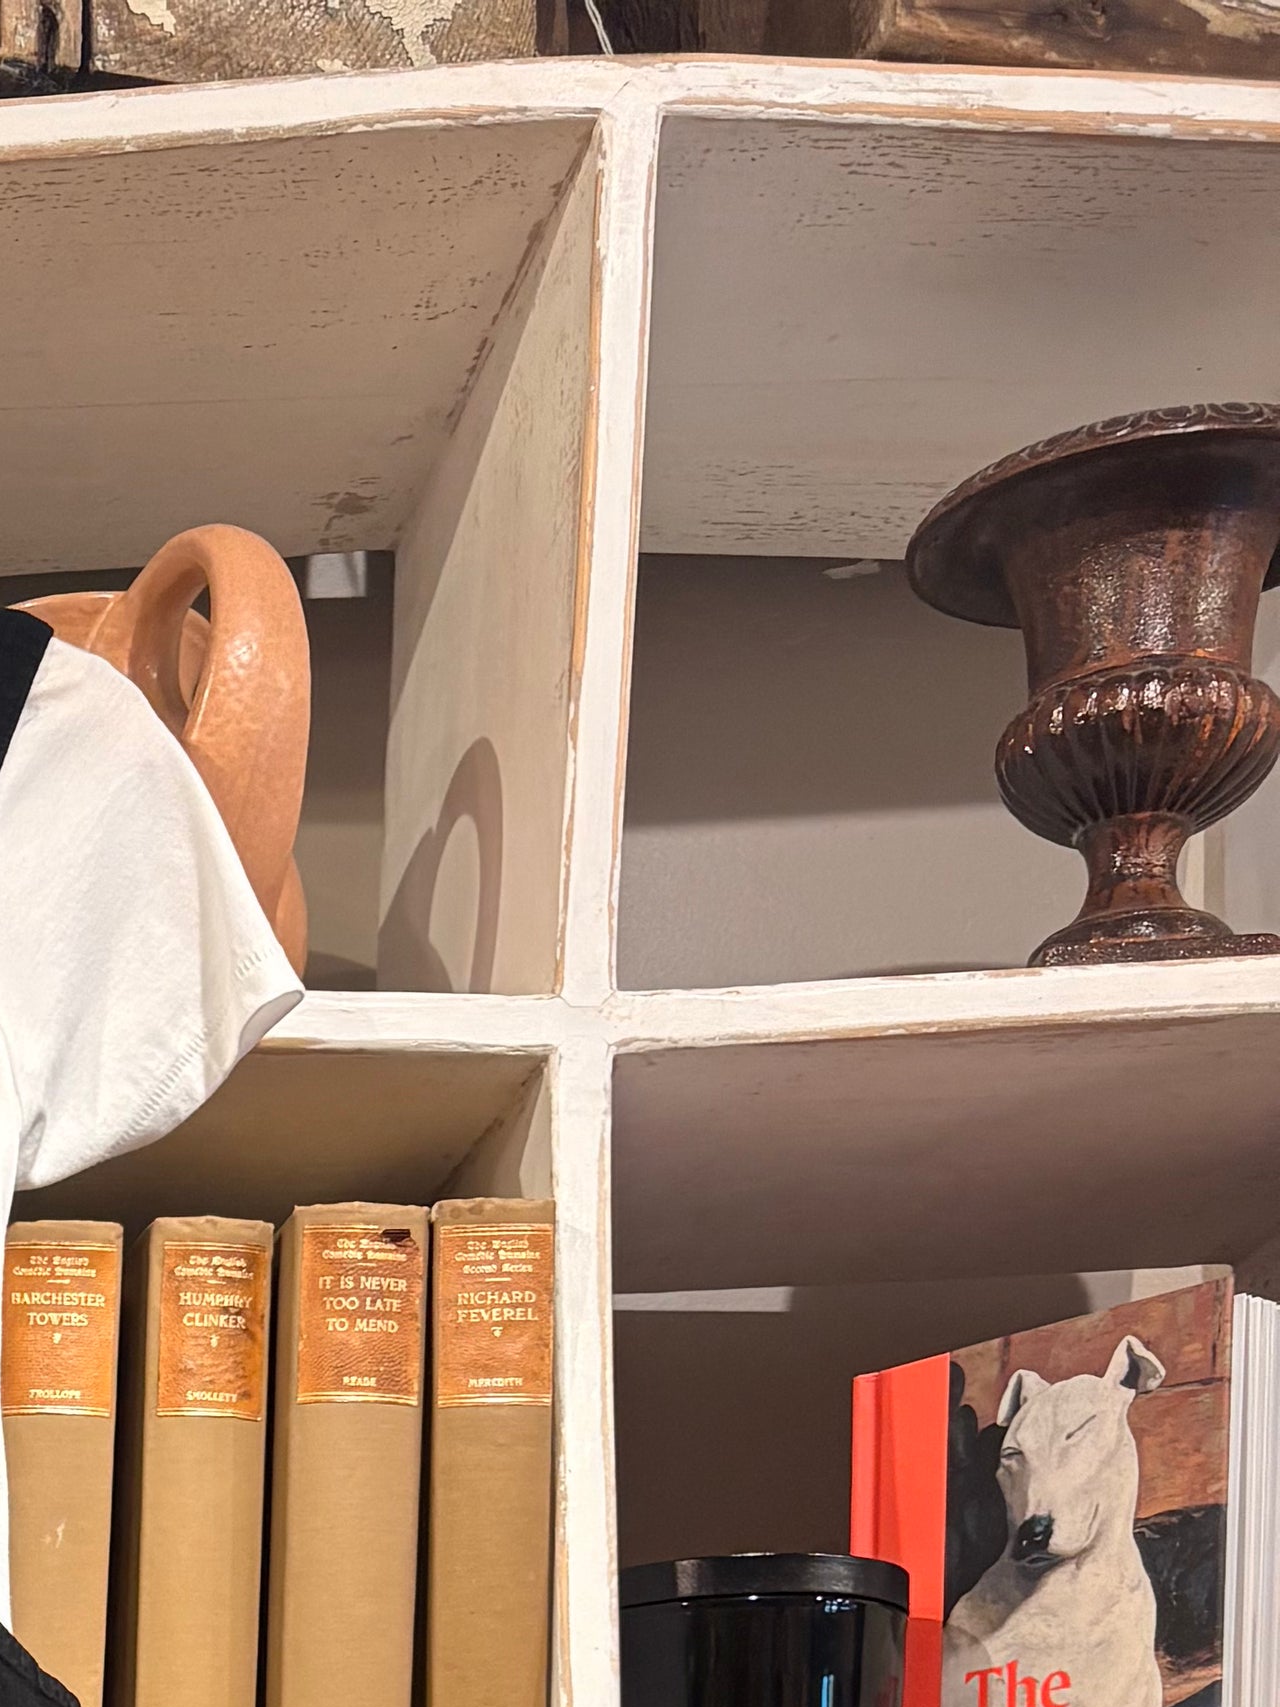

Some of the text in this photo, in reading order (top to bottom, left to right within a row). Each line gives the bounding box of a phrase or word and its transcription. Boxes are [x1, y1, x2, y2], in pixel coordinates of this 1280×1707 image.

[319, 1276, 408, 1292] IT IS NEVER
[11, 1292, 106, 1308] BARCHESTER
[178, 1291, 254, 1310] HUMPHRY
[324, 1297, 402, 1312] TOO LATE
[456, 1290, 537, 1306] RICHARD
[27, 1312, 90, 1327] TOWERS
[182, 1313, 247, 1330] CLINKER
[456, 1307, 540, 1323] FEVEREL
[326, 1318, 400, 1334] TO MEND
[468, 1377, 523, 1388] MEREDITH
[186, 1390, 238, 1403] SMOLLETT
